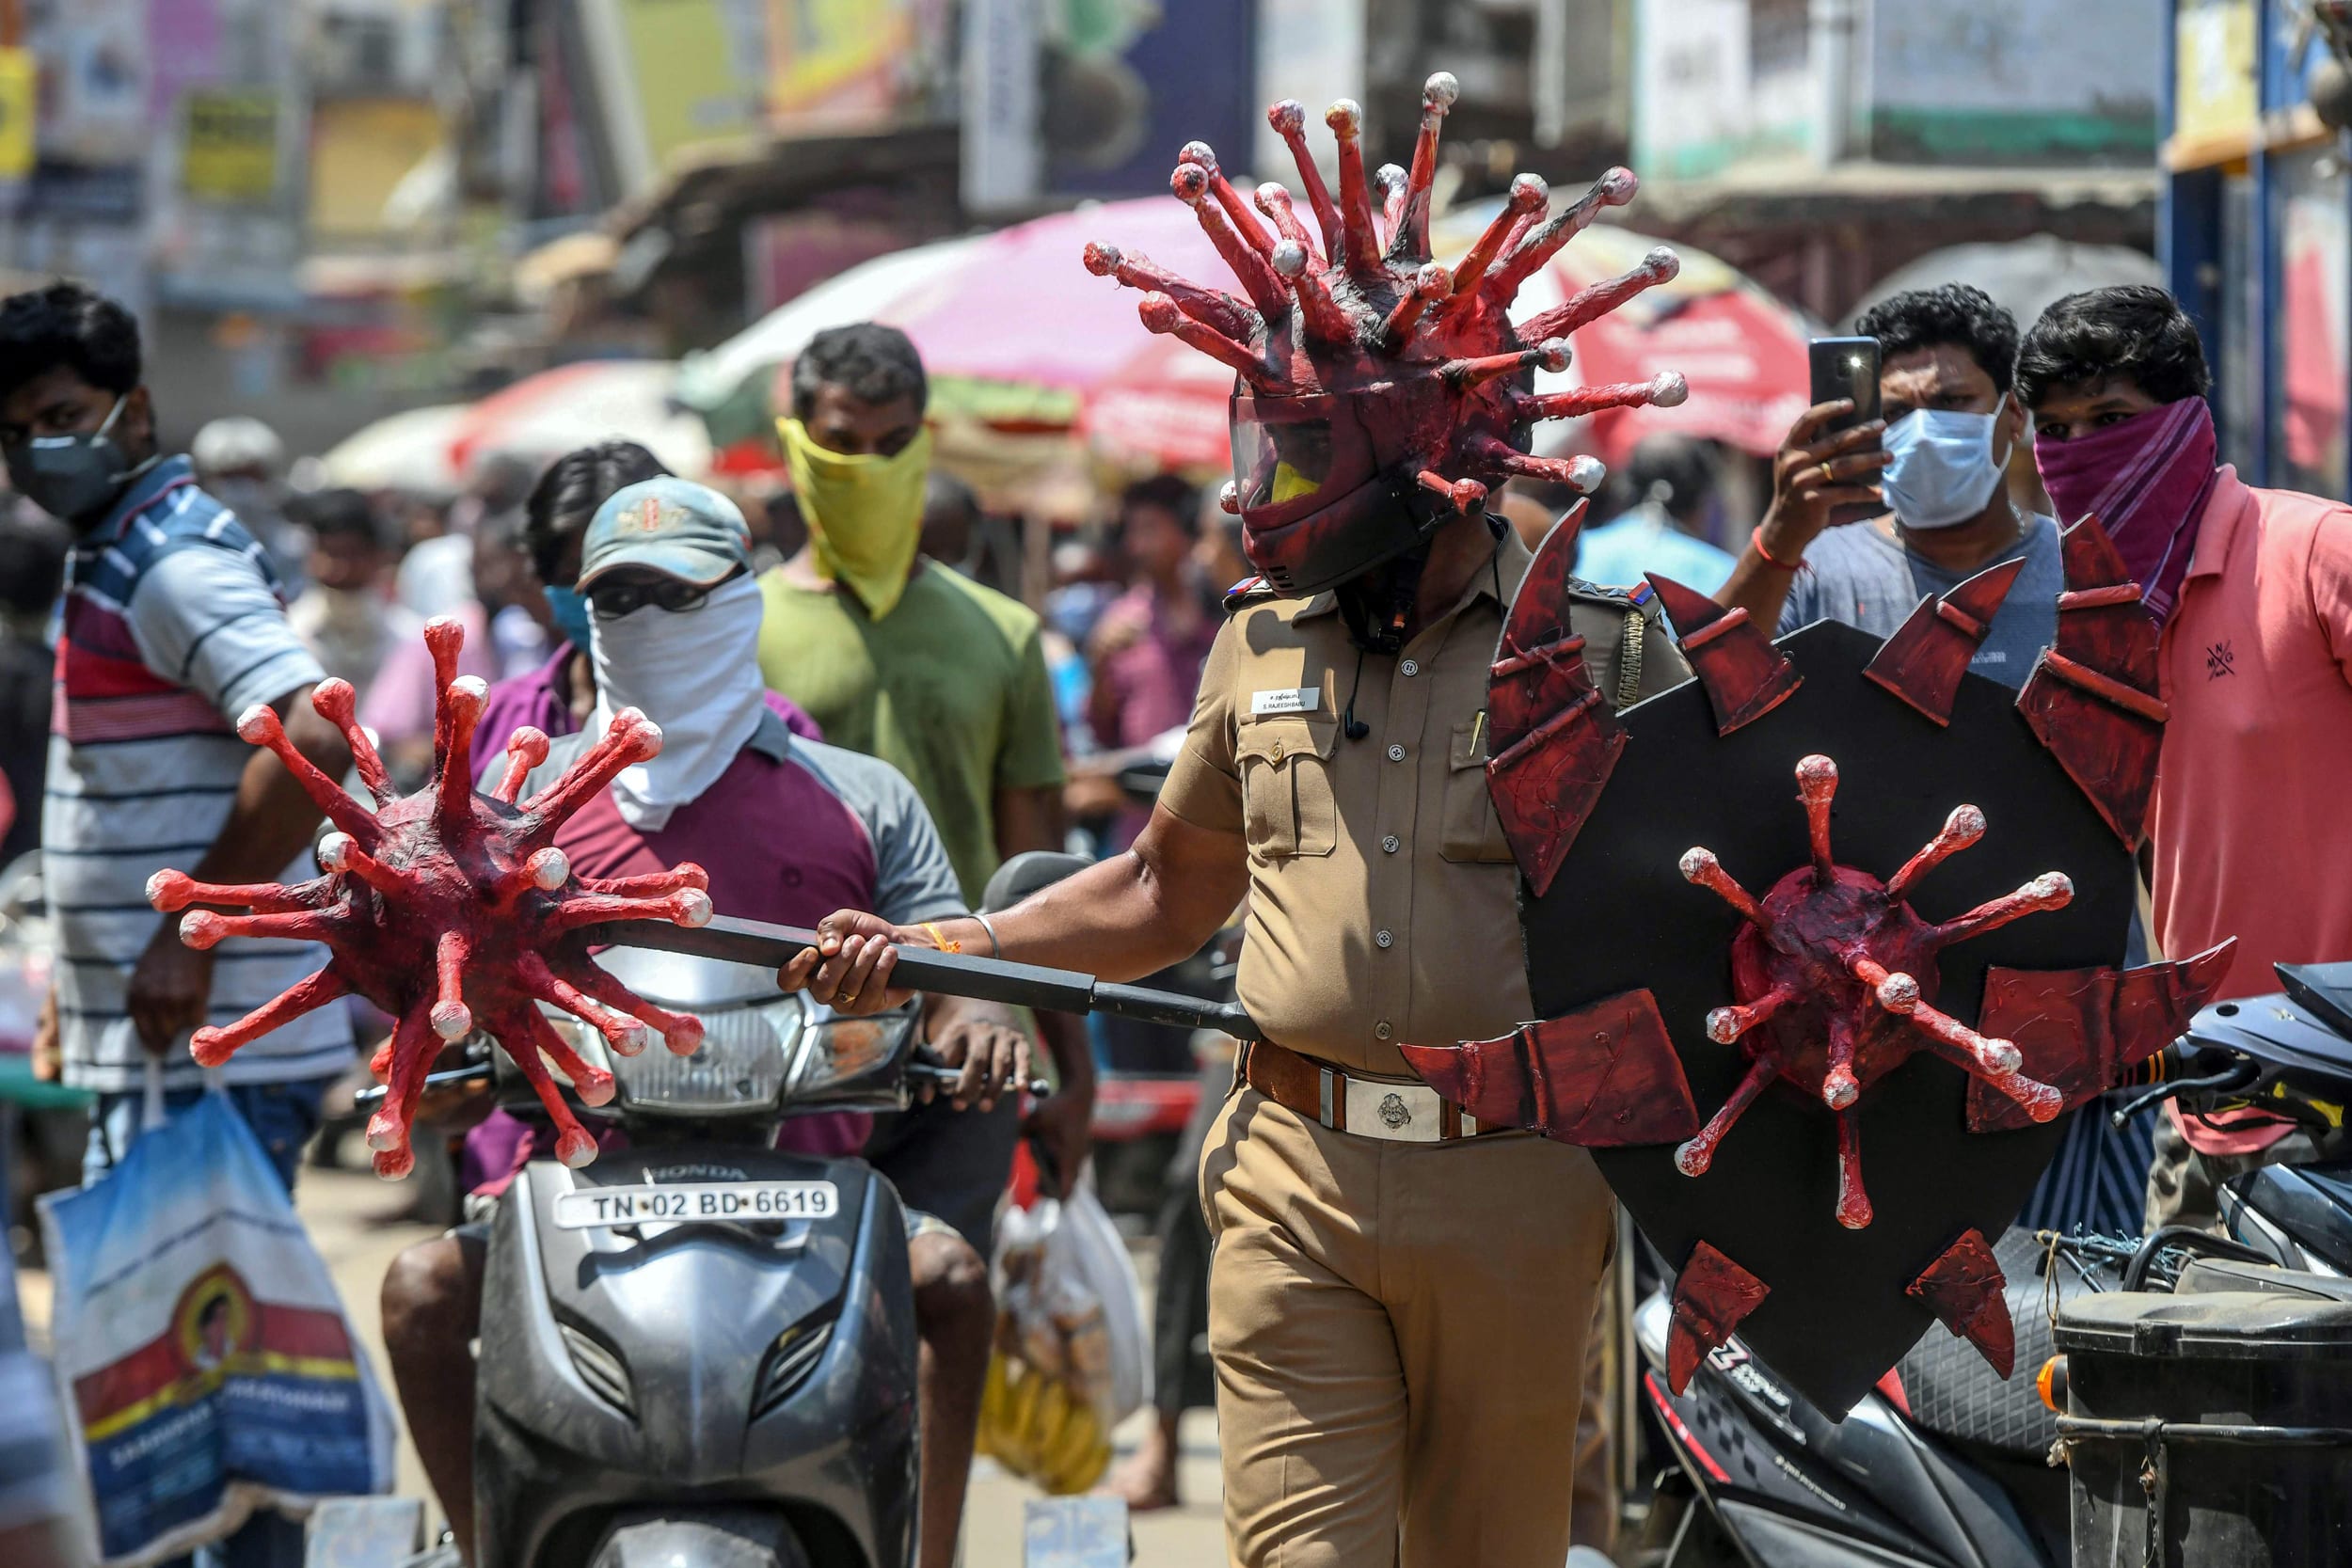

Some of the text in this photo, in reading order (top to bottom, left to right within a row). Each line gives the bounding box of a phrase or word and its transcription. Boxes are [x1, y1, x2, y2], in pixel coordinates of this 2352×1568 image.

[652, 1164, 748, 1180] HONDA
[592, 1191, 827, 1220] TN 02 BD 6619
